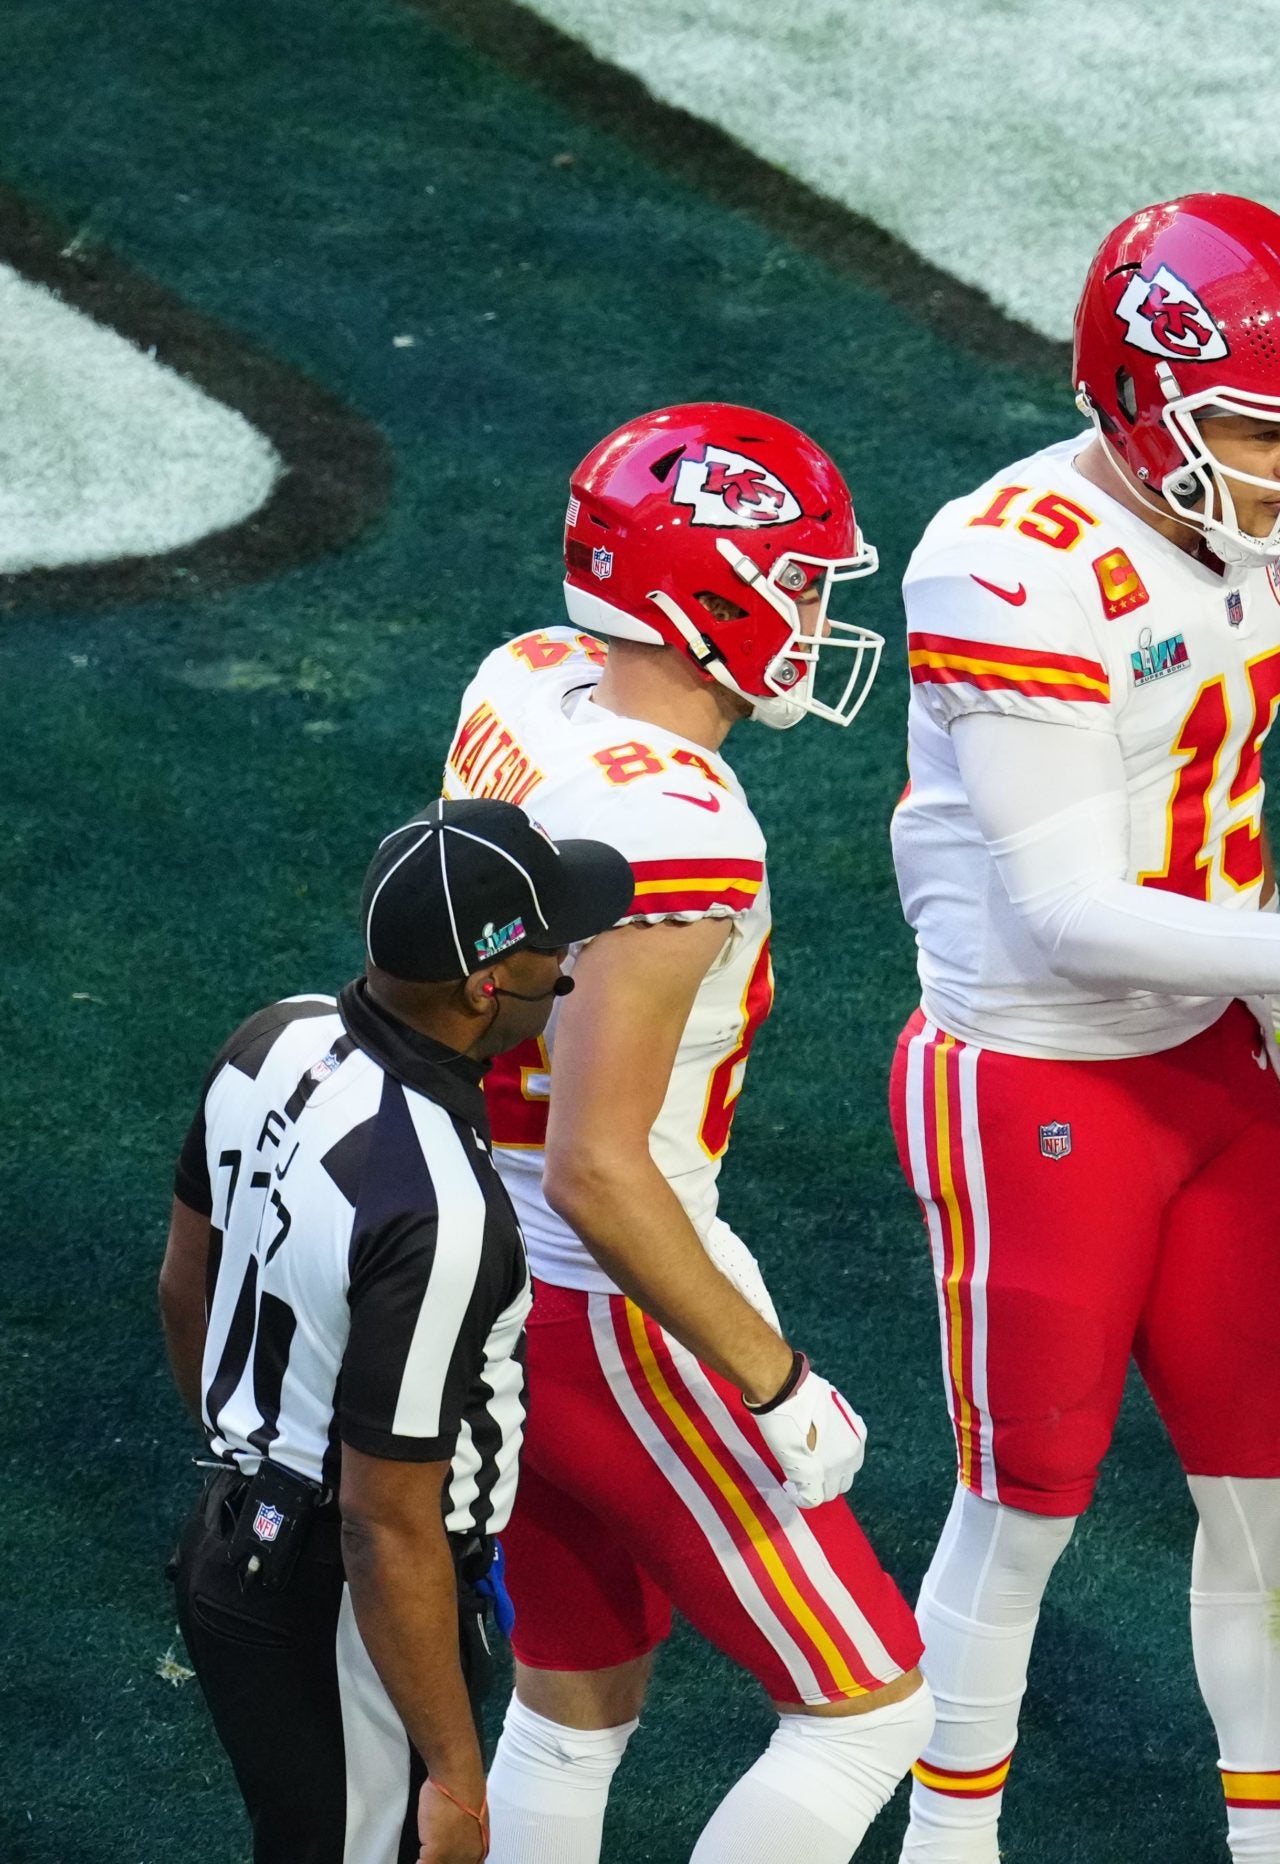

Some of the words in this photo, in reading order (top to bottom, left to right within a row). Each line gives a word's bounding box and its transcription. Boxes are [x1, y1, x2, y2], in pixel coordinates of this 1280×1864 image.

[1136, 284, 1213, 357] KC
[699, 460, 786, 521] KC
[966, 484, 1101, 553] 15
[1101, 553, 1140, 601] C
[1140, 671, 1164, 683] SUPER
[1166, 663, 1185, 674] BOWL
[447, 699, 548, 807] WATSON
[590, 741, 731, 792] 84
[256, 1516, 275, 1537] NFL
